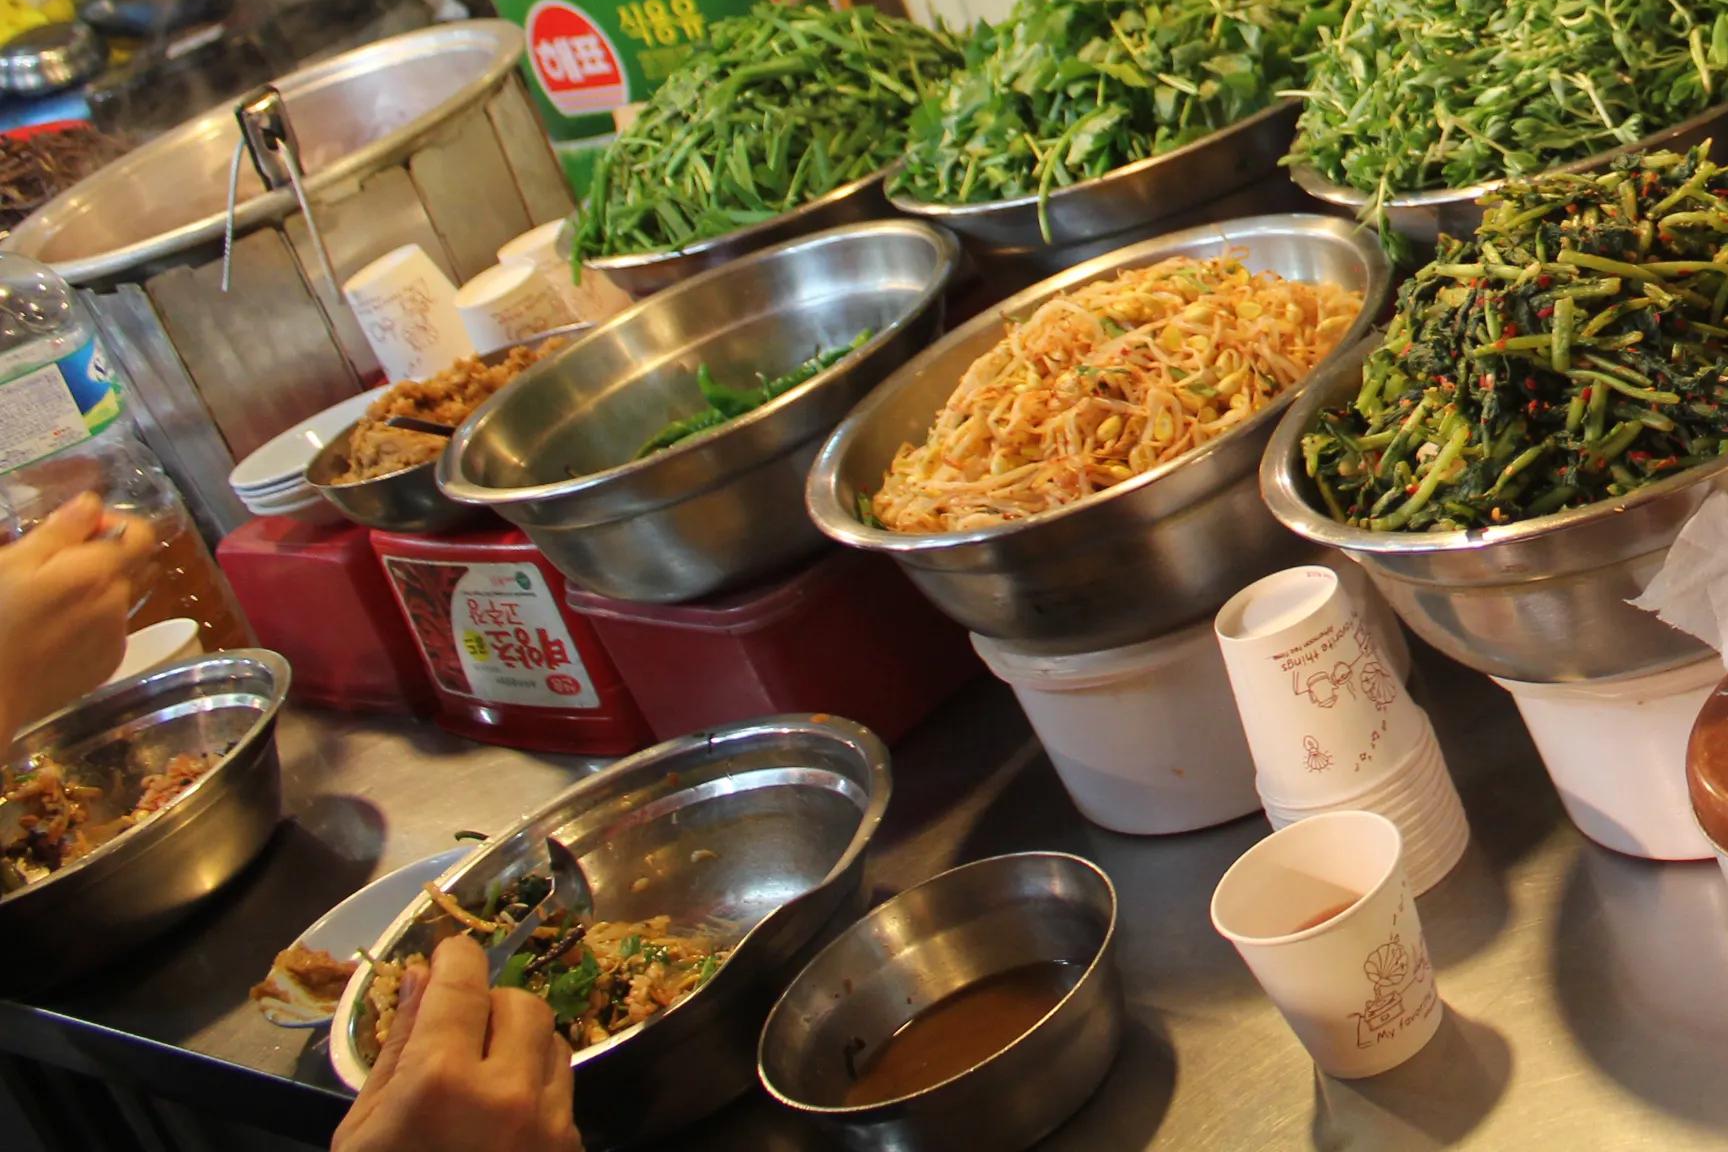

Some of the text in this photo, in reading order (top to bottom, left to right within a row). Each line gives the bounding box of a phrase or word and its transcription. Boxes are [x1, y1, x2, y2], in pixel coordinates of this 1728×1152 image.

[466, 599, 525, 627] 고추장
[485, 627, 572, 670] 태양초
[1281, 649, 1320, 672] things
